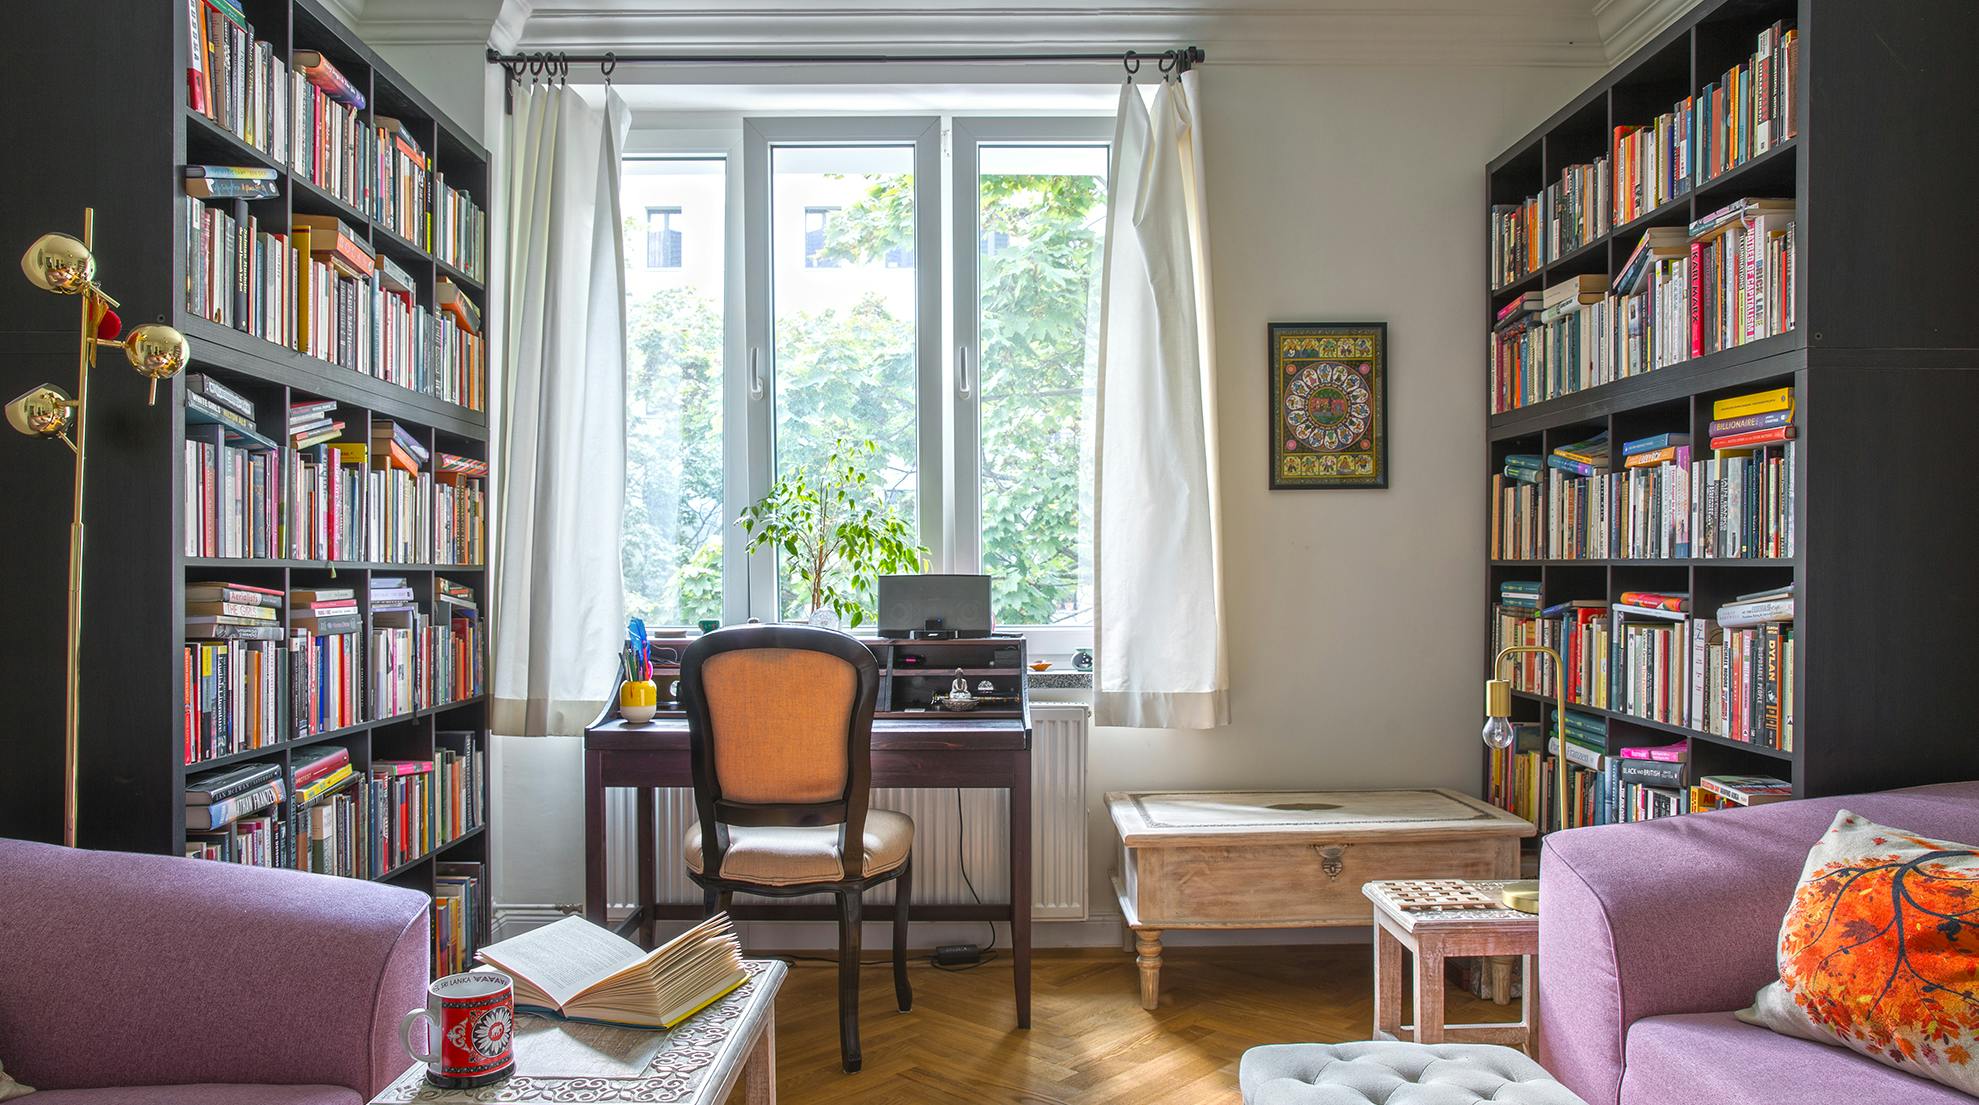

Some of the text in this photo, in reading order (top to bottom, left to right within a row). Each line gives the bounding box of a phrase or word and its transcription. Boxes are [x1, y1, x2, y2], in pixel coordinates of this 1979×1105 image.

[1746, 226, 1755, 332] HATRED OF CAPITALISM
[1692, 285, 1700, 322] MARX
[1755, 258, 1764, 326] BRICK LANE
[347, 288, 355, 340] ZADIE SMITH
[1716, 417, 1756, 431] BILLIONAIRE
[225, 603, 257, 617] THE GIRLS
[1768, 640, 1776, 681] DYLAN
[1757, 682, 1765, 704] PEOPLE
[1622, 767, 1637, 775] BLACK
[1643, 768, 1661, 777] BRITISH
[252, 787, 276, 811] FRANZEN
[450, 976, 471, 986] LANKA
